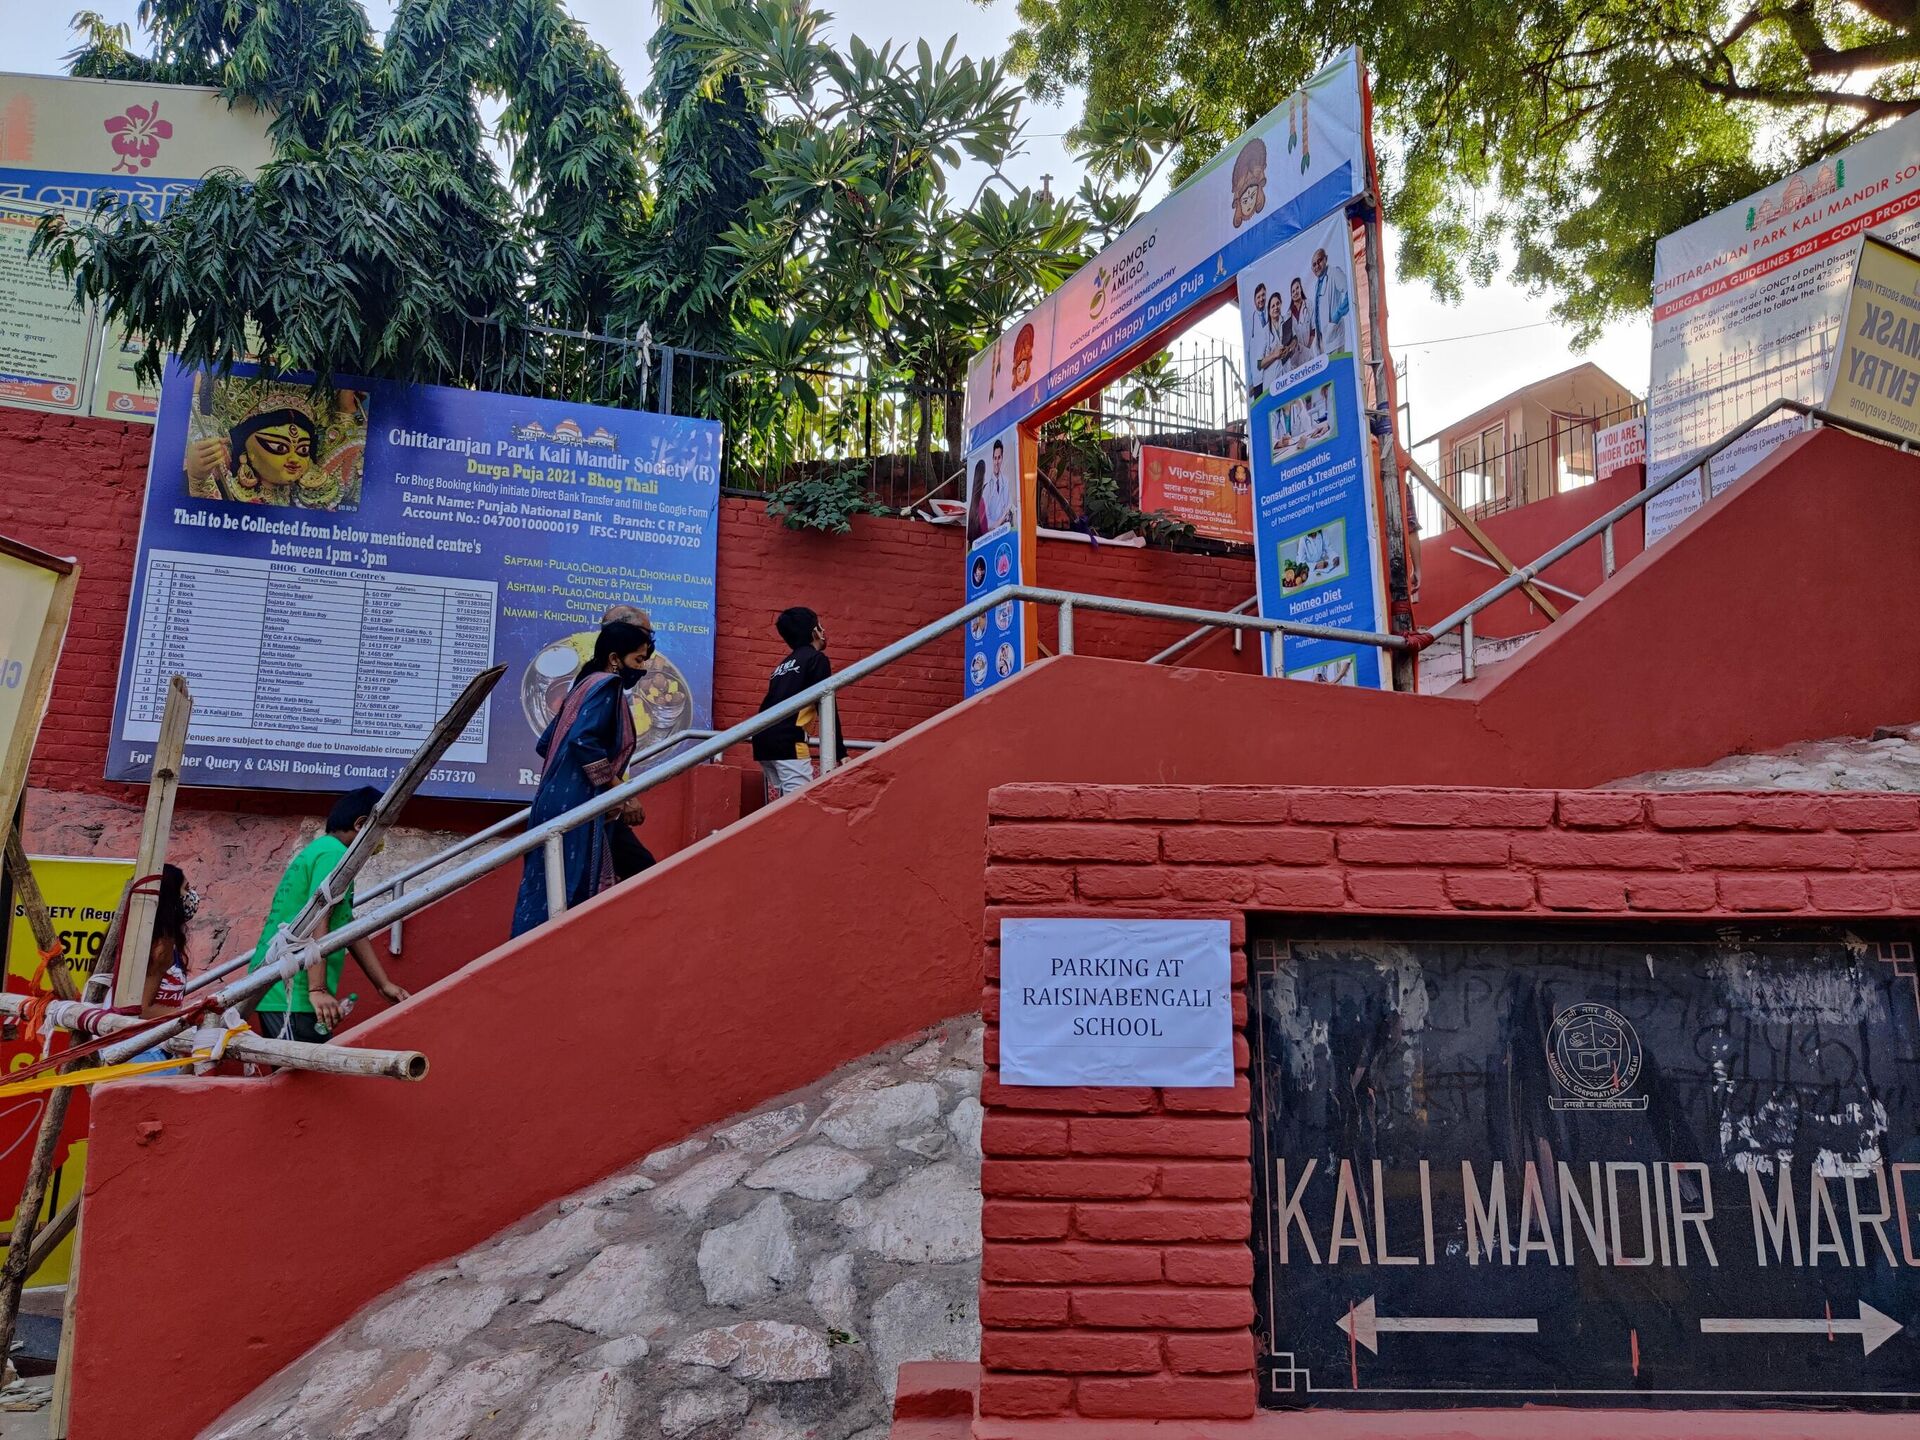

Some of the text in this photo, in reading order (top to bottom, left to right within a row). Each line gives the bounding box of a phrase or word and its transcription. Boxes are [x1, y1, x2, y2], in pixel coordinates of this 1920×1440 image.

[1655, 165, 1920, 295] CHITTARANJAN PARK KALI MANDIR SO
[1111, 234, 1156, 278] HOMOEO
[1664, 293, 1700, 316] DURGA
[1702, 281, 1728, 300] PUJA
[1730, 255, 1790, 286] GUIDELINES
[1792, 239, 1819, 260] 2021
[1831, 216, 1872, 240] COVID
[1876, 194, 1920, 221] PROTO
[1111, 261, 1144, 294] AMIGO
[1707, 260, 1825, 319] guidelines GONCT Delhi
[1740, 300, 1762, 317] order
[1780, 285, 1796, 298] 474
[1796, 277, 1815, 291] and
[1816, 269, 1833, 282] 475
[1070, 329, 1091, 350] CHOOSE
[1109, 300, 1133, 319] CHOOSE
[1133, 266, 1177, 303] HOMEOPATHY
[1727, 295, 1799, 330] decided follow
[1047, 360, 1080, 390] Wishing
[1082, 348, 1099, 367] You
[1100, 336, 1113, 355] All
[1115, 314, 1146, 343] Happy
[1147, 294, 1178, 321] Durga
[1180, 272, 1205, 298] Puja
[1275, 360, 1323, 391] Our Services:
[1597, 438, 1647, 464] UNDER CCTV
[1603, 425, 1637, 447] YOU ARE
[389, 428, 715, 485] Chittaranjan Park Kali Mandir Society (R)
[1280, 451, 1331, 483] Homeopathic
[467, 458, 659, 495] Durga Puja 2021 Bhog Thali
[1168, 465, 1226, 484] VijayShree
[1261, 457, 1357, 507] Consultation Treatment
[395, 473, 708, 518] For Bhog Booking kindly initiate Direct Bank Transfer and fill the Google Form
[1272, 474, 1356, 515] more secrecy prescription
[402, 491, 703, 535] Bank Name: Punjab National Bank Branch: C R Park
[402, 507, 701, 548] Account No.: 0470010000019 IFSC: PUNB0047020
[1278, 503, 1315, 525] homeopathy
[173, 508, 482, 554] Thali to be Collected from below mentioned centre's
[270, 539, 387, 567] between 1pm 3pm
[270, 562, 386, 582] BHOG Collection Centre's
[504, 555, 713, 586] SAPTAMI DALNA
[567, 574, 653, 592] CHUTNEY PAYESH
[506, 580, 709, 611] ASHTAMI PANEER
[566, 599, 608, 612] CHUTNEY
[1289, 588, 1342, 615] Homeo Diet
[503, 606, 590, 625] NAVAMI KHICHUDI,
[1314, 602, 1354, 622] goal without
[677, 623, 710, 635] PAYESH
[217, 735, 384, 754] are subject change due Unavoidable
[130, 750, 388, 779] For Query & CASH Booking Contact
[1051, 957, 1185, 978] PARKING AT
[1022, 987, 1213, 1008] RAISINABENGALI
[1072, 1017, 1164, 1037] SCHOOL
[1550, 1052, 1639, 1098] MUNICIPAL CORPORATION OF DELHI
[1276, 1158, 1436, 1266] KALI
[1461, 1159, 1719, 1267] MANDIR
